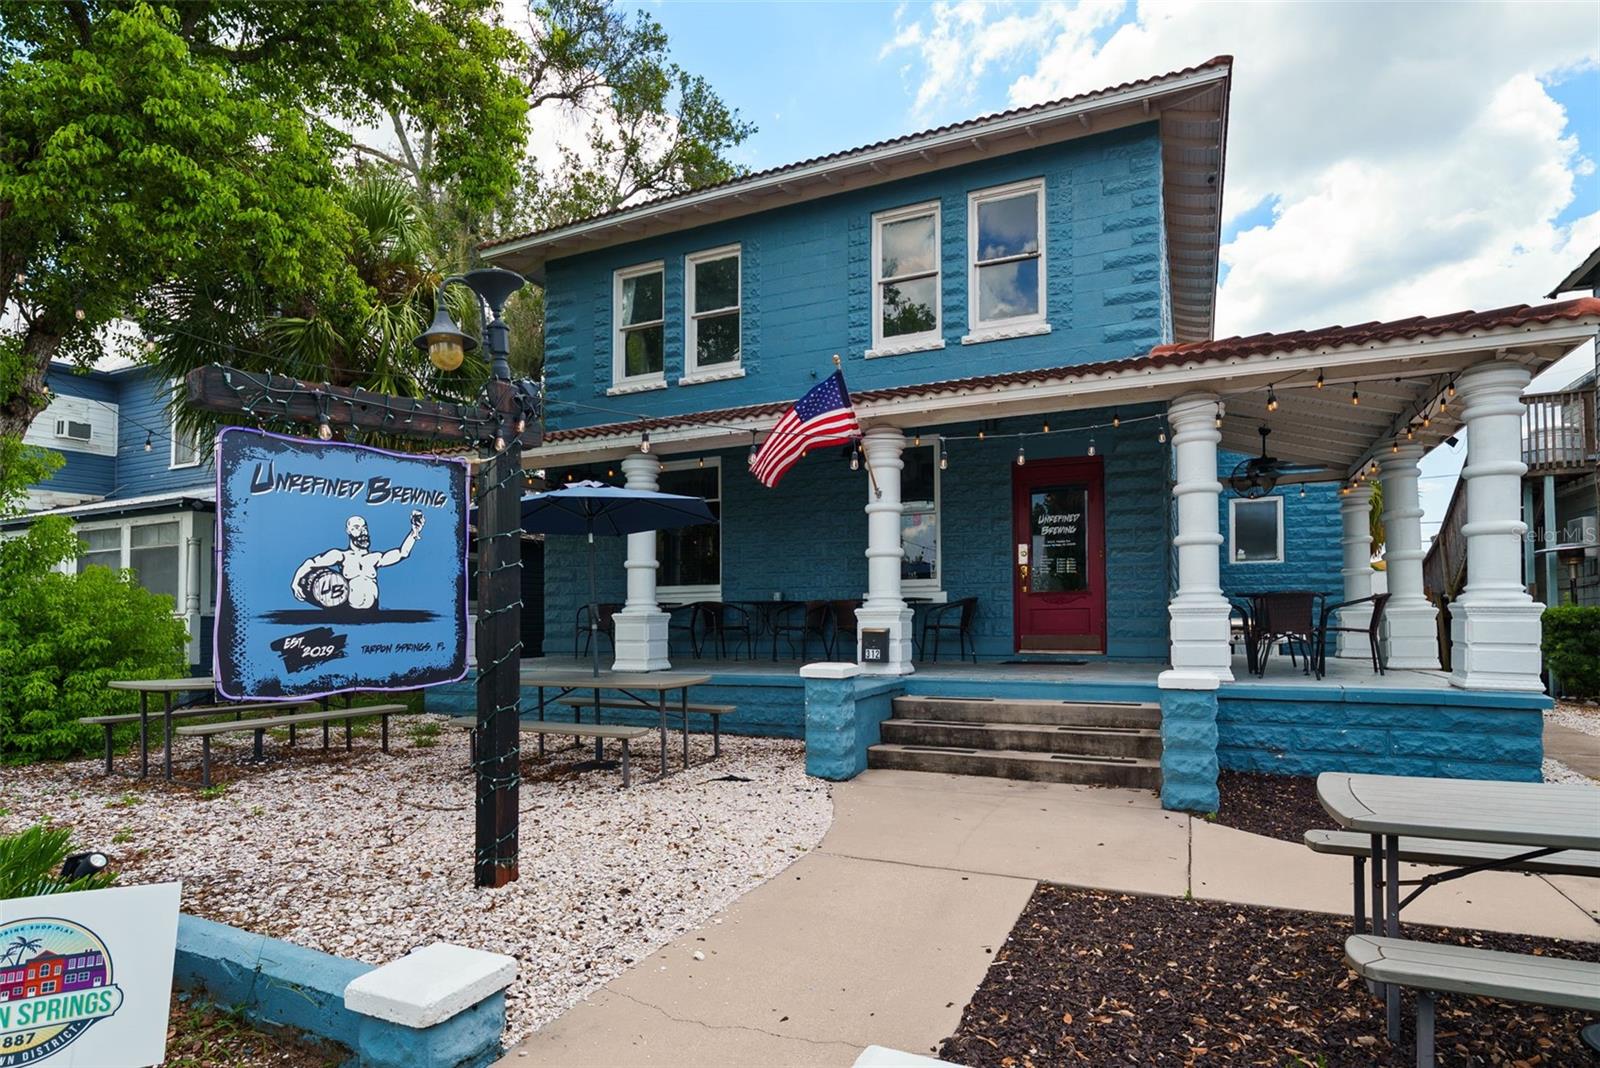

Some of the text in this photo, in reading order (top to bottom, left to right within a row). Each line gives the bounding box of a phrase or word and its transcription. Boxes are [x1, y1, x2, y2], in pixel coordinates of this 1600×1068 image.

[250, 459, 449, 508] UNREFINED BREWING
[1038, 513, 1080, 524] UNREFINED
[1041, 525, 1077, 535] BREWING
[321, 580, 344, 599] UB
[283, 636, 335, 658] EST. 2019
[360, 644, 393, 654] TARPON
[17, 990, 112, 1025] SPRINGS
